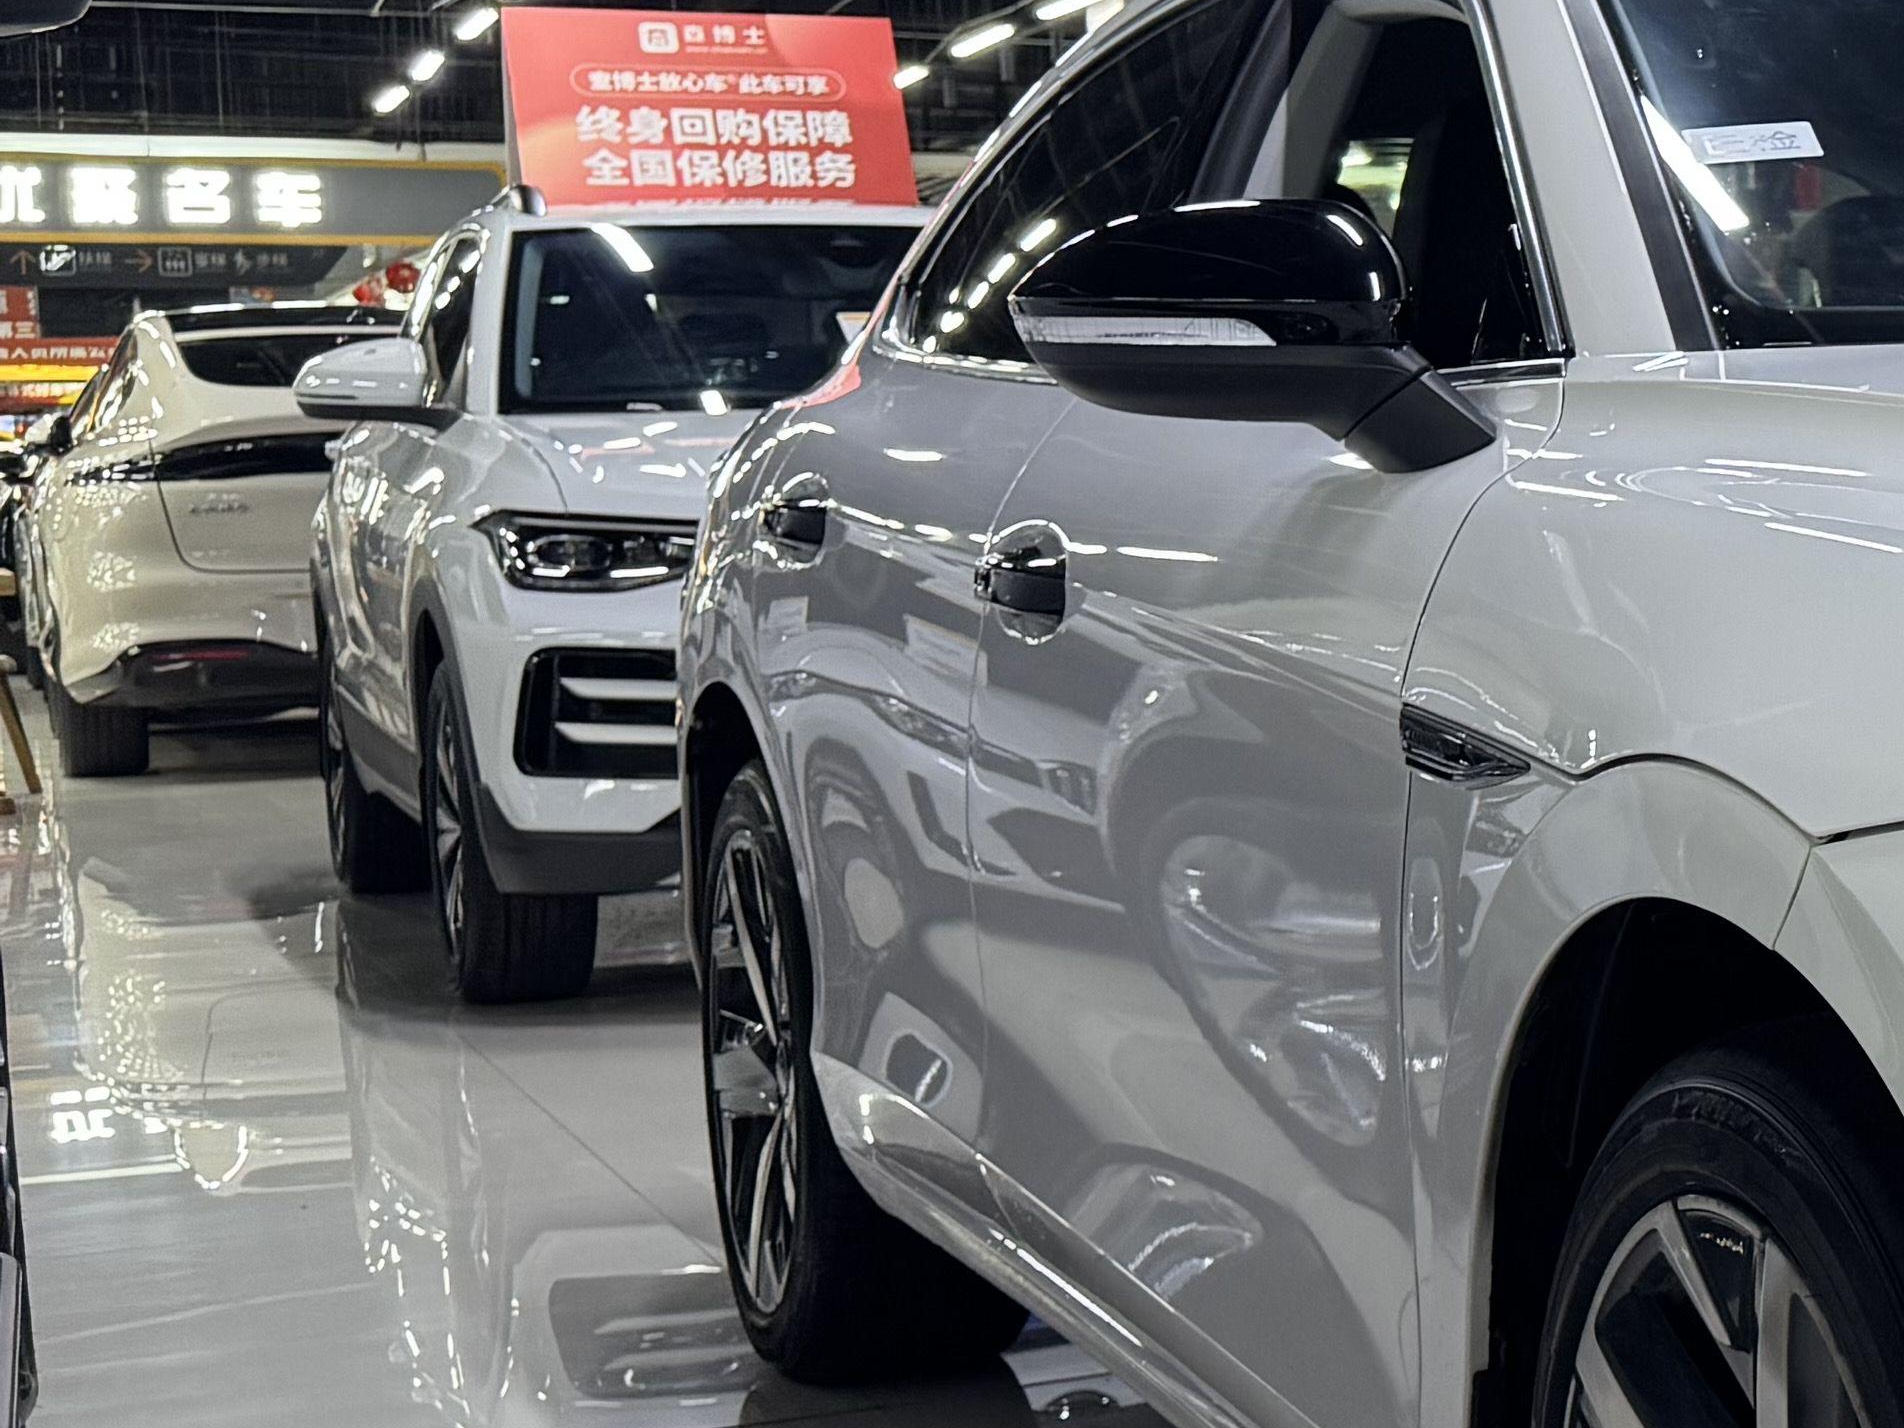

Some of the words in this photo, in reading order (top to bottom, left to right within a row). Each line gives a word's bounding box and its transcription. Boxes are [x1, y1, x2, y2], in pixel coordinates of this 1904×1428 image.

[575, 105, 853, 148] 终身回购保障
[582, 148, 856, 188] 全国保修服务
